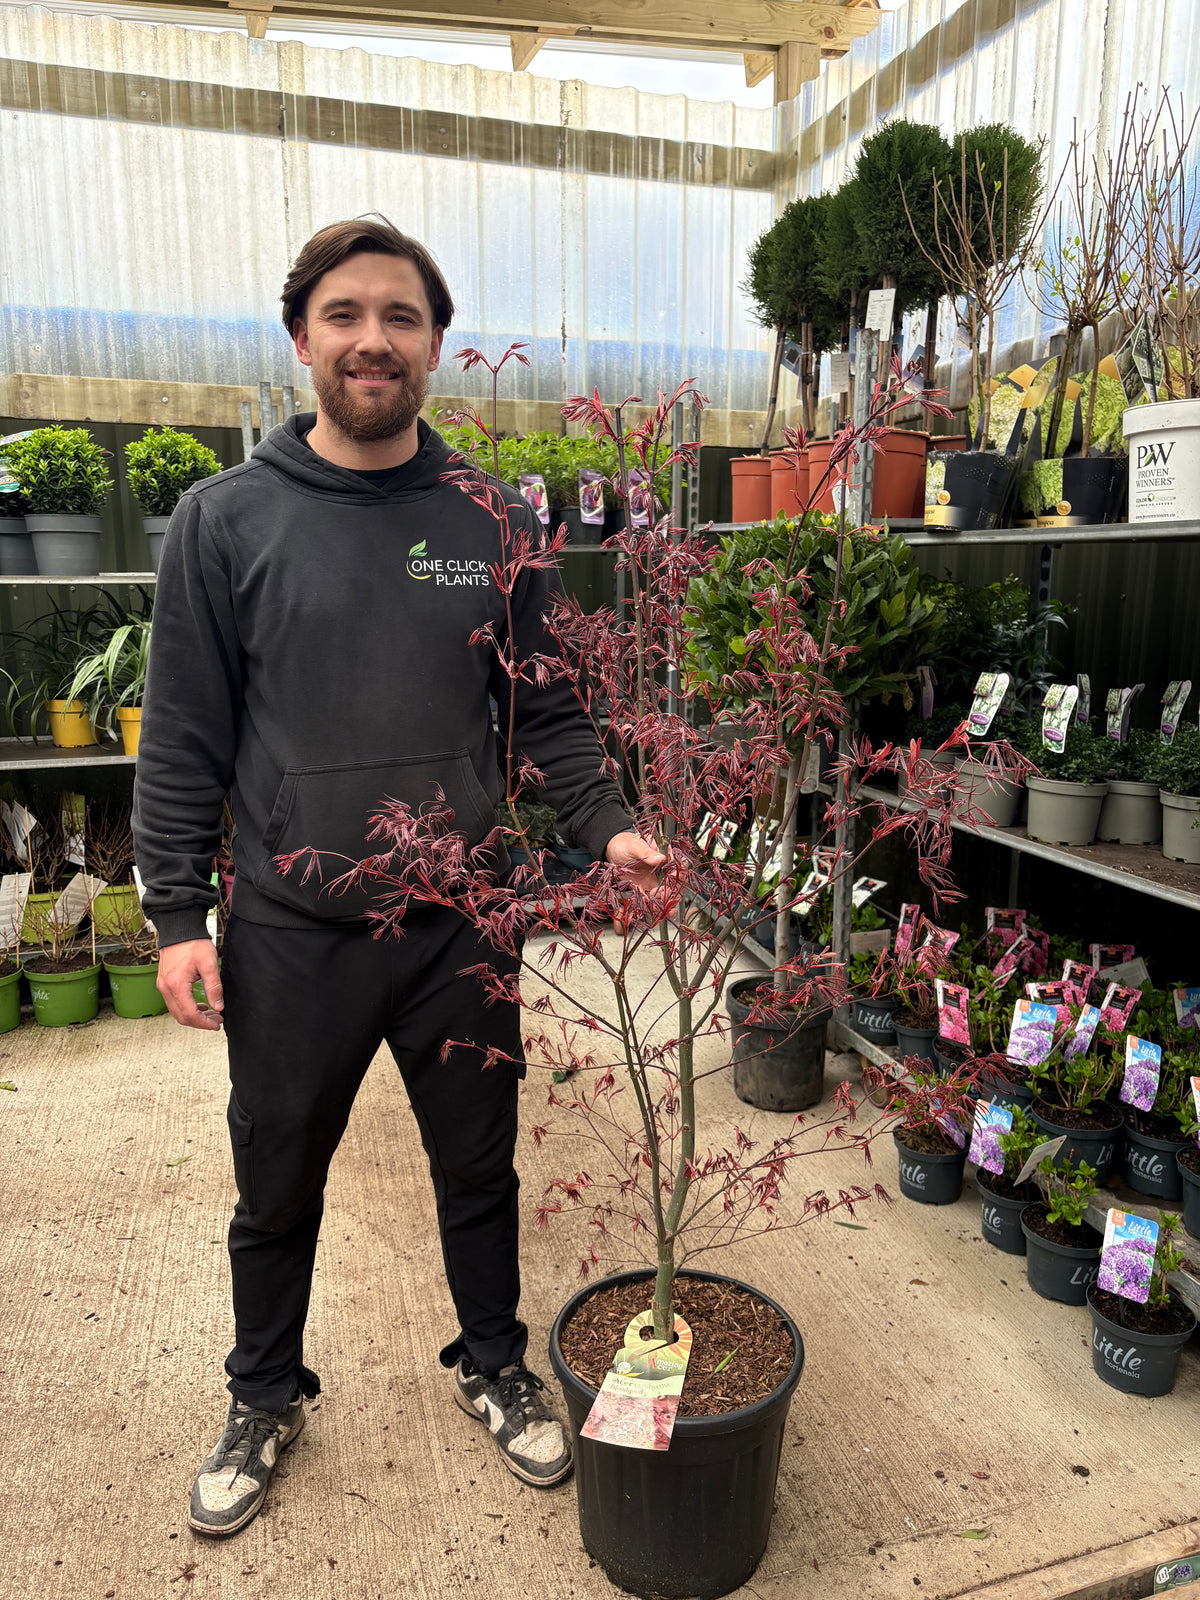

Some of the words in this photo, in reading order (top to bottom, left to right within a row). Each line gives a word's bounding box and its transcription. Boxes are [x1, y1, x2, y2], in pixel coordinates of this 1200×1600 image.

[1136, 441, 1176, 470] PW
[1137, 468, 1169, 480] PROVEN
[411, 559, 444, 572] ONE
[446, 560, 488, 572] CLICK
[436, 574, 490, 586] PLANTS
[1032, 1007, 1053, 1019] Little
[1127, 1221, 1152, 1237] Little
[1093, 1327, 1142, 1371] Little
[1104, 1358, 1140, 1379] Hortensia
